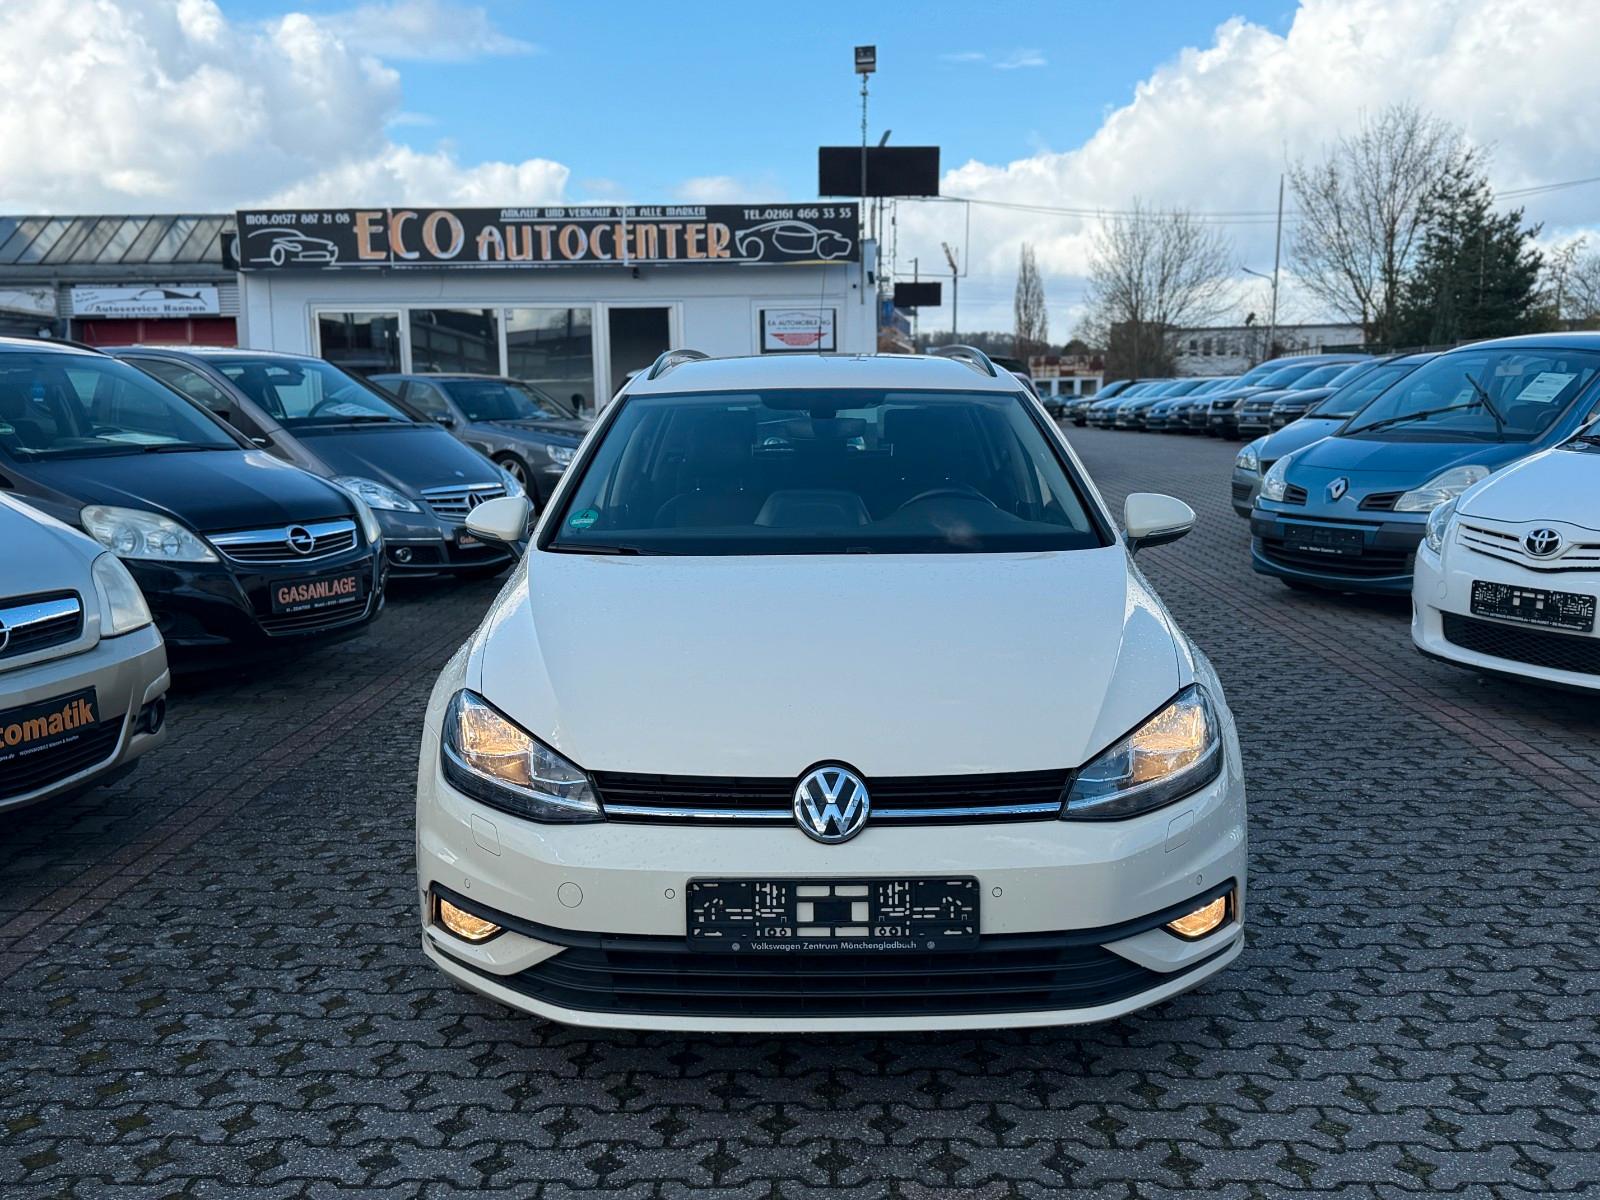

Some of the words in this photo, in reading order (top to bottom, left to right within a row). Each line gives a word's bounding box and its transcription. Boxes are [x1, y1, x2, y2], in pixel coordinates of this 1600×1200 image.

[501, 208, 538, 218] ANKAUF
[544, 208, 566, 217] UND
[568, 207, 610, 217] VERKAUF
[615, 206, 636, 217] VON
[640, 206, 662, 216] ALLE
[666, 206, 706, 216] MARKEN
[797, 208, 819, 219] 466
[822, 207, 836, 219] 33
[839, 207, 852, 219] 55
[322, 213, 332, 224] 21
[353, 210, 465, 260] ECO
[475, 223, 731, 260] AUTOCENTER
[95, 304, 158, 313] Autoservice
[278, 576, 356, 604] GASANLAGE
[751, 942, 801, 952] Volkswagen
[803, 942, 839, 950] Zentrum
